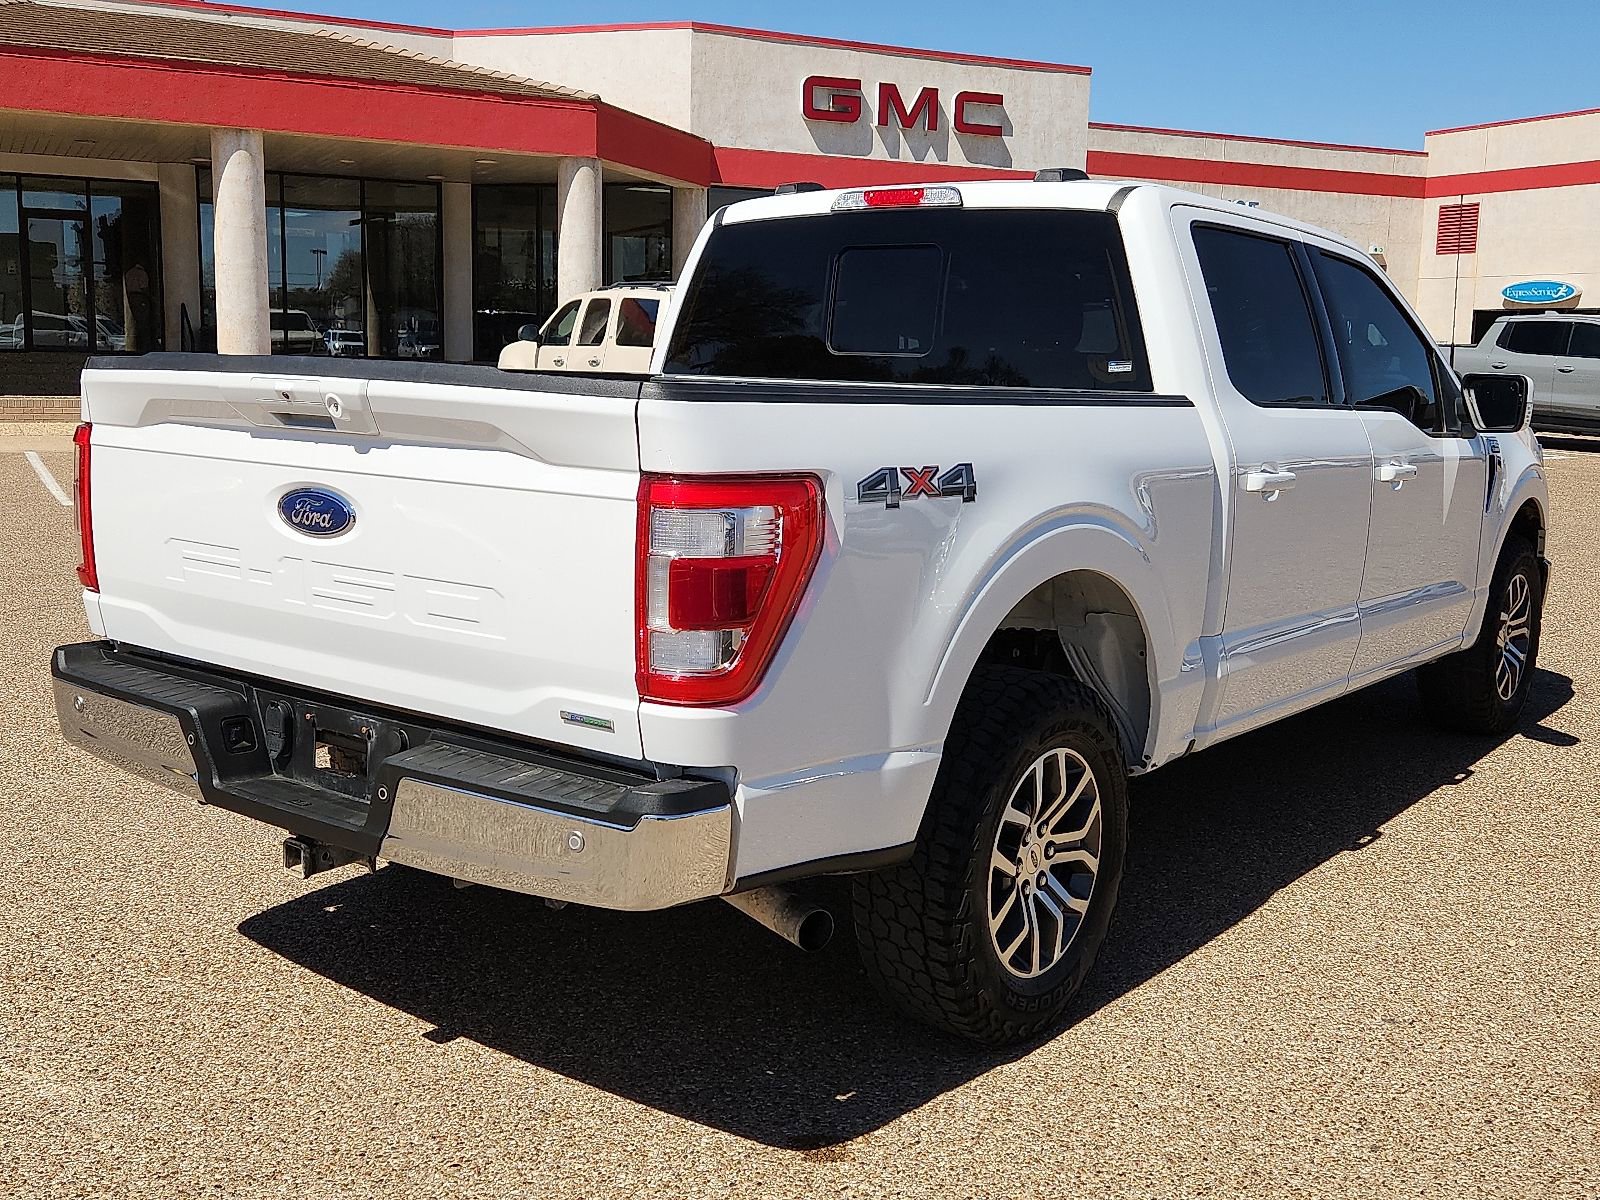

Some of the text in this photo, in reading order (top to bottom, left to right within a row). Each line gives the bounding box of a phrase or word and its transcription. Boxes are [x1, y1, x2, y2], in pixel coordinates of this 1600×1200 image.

[801, 75, 1004, 137] GMC
[291, 497, 335, 528] Ford
[164, 537, 507, 641] F-150
